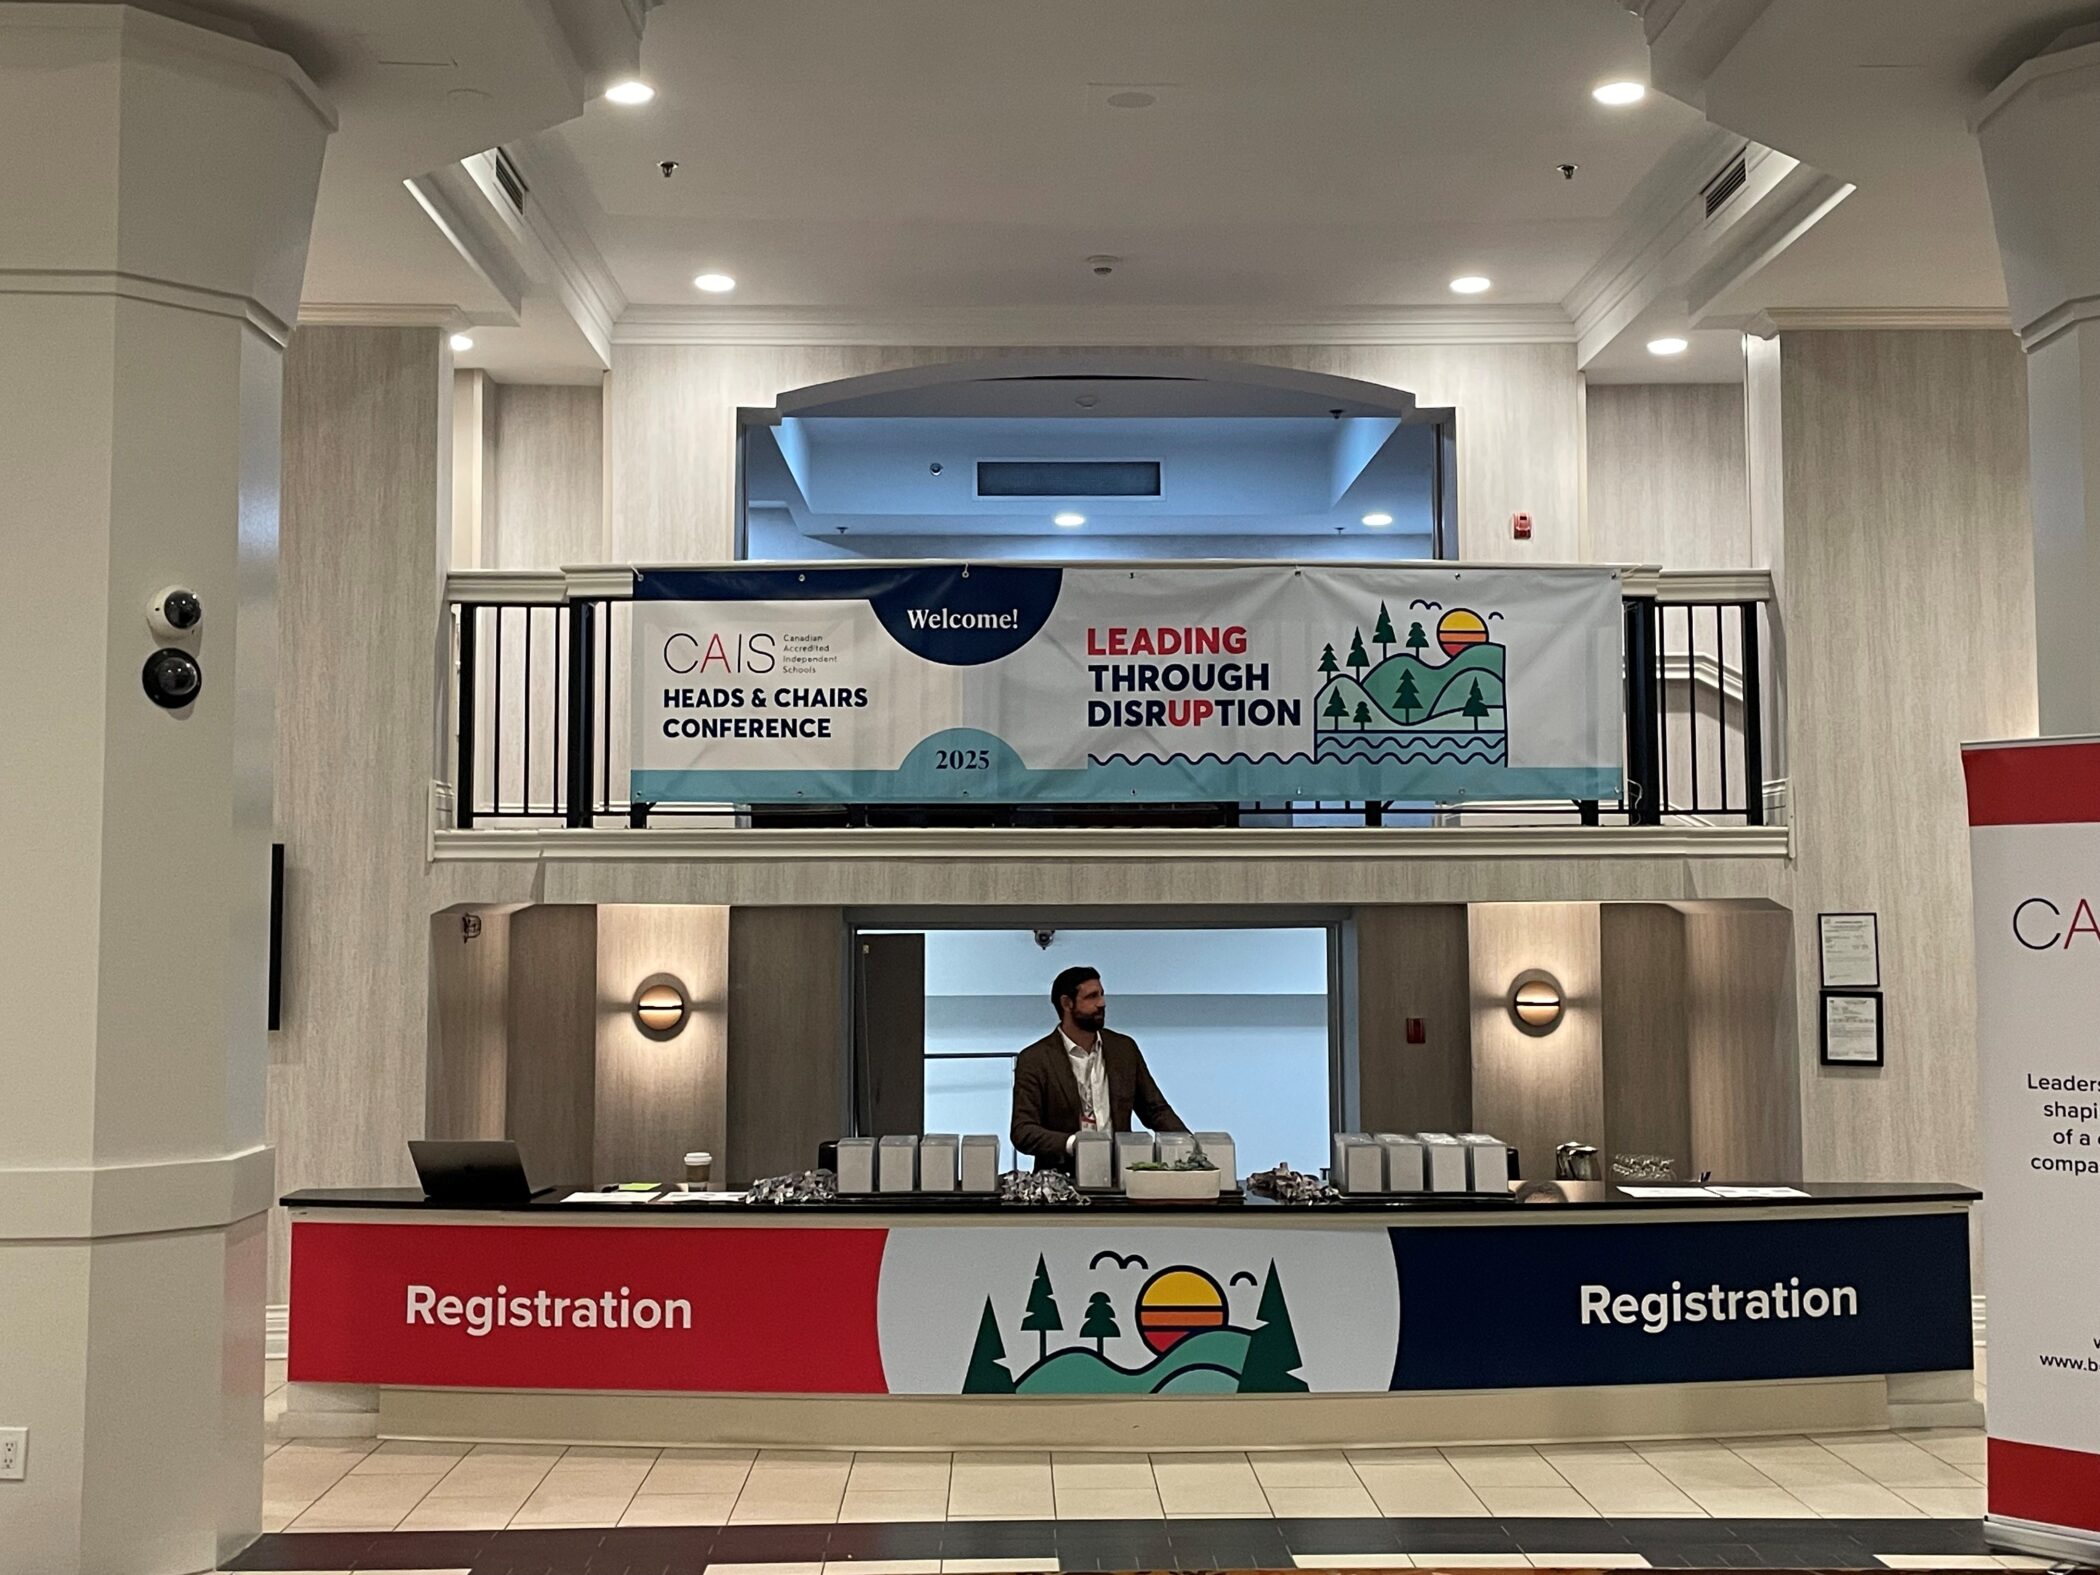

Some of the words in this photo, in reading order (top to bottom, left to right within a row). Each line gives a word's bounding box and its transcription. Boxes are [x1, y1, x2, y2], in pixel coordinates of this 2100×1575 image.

[907, 607, 1019, 629] Welcome!
[783, 634, 823, 642] Canadian
[783, 644, 830, 653] Accredited
[1087, 625, 1247, 656] LEADING
[663, 632, 776, 674] CAIS
[782, 655, 837, 664] Independent
[782, 665, 817, 674] Schools
[1087, 662, 1270, 693] THROUGH
[663, 688, 745, 708] HEADS
[751, 687, 767, 708] &
[774, 687, 868, 708] CHAIRS
[1087, 698, 1301, 728] DISRUPTION
[662, 718, 832, 739] CONFERENCE
[935, 749, 990, 770] 2025
[2012, 897, 2100, 951] CA
[2043, 1100, 2098, 1123] shapi
[2053, 1128, 2073, 1145] of
[2079, 1132, 2091, 1146] a
[2030, 1157, 2099, 1177] compa
[405, 1284, 692, 1337] Registration
[1580, 1276, 1859, 1335] Registration
[2039, 1354, 2100, 1372] www.b
